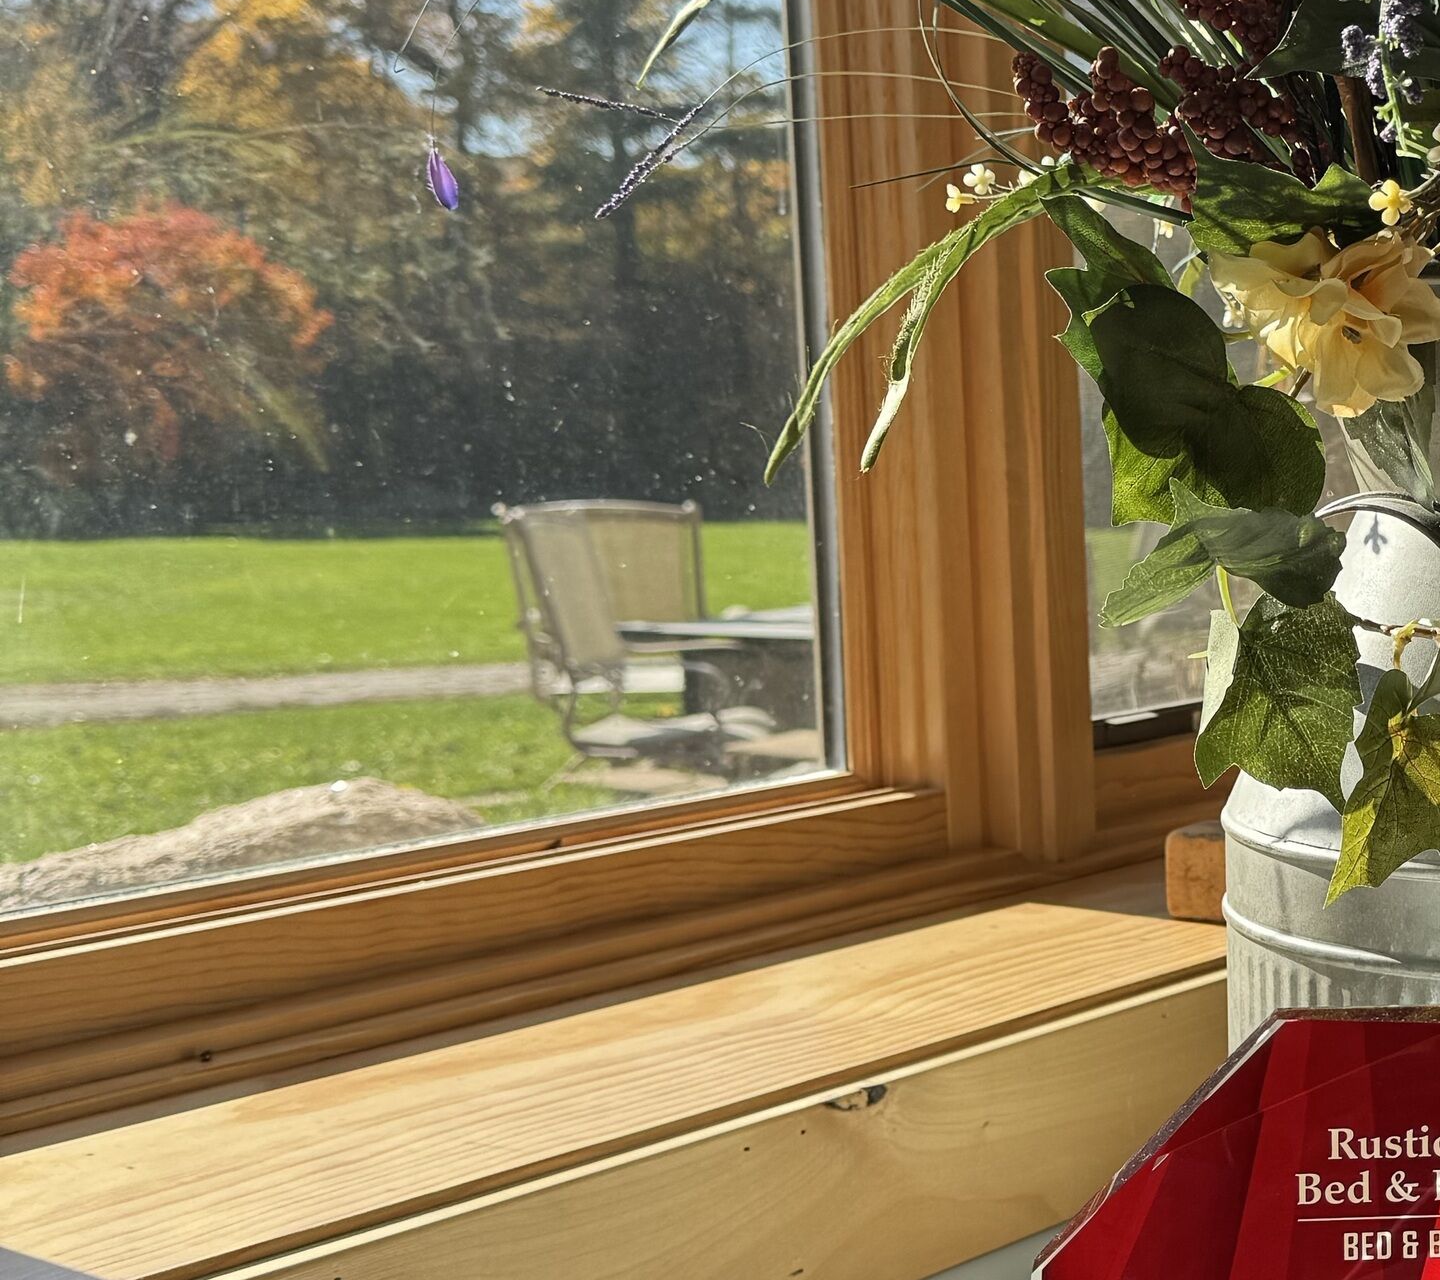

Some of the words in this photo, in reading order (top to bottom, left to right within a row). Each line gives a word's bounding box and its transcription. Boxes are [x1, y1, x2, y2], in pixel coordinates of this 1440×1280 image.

[1295, 1171, 1372, 1207] Bed
[1384, 1170, 1421, 1204] &
[1343, 1231, 1392, 1260] BED
[1402, 1230, 1419, 1259] &
